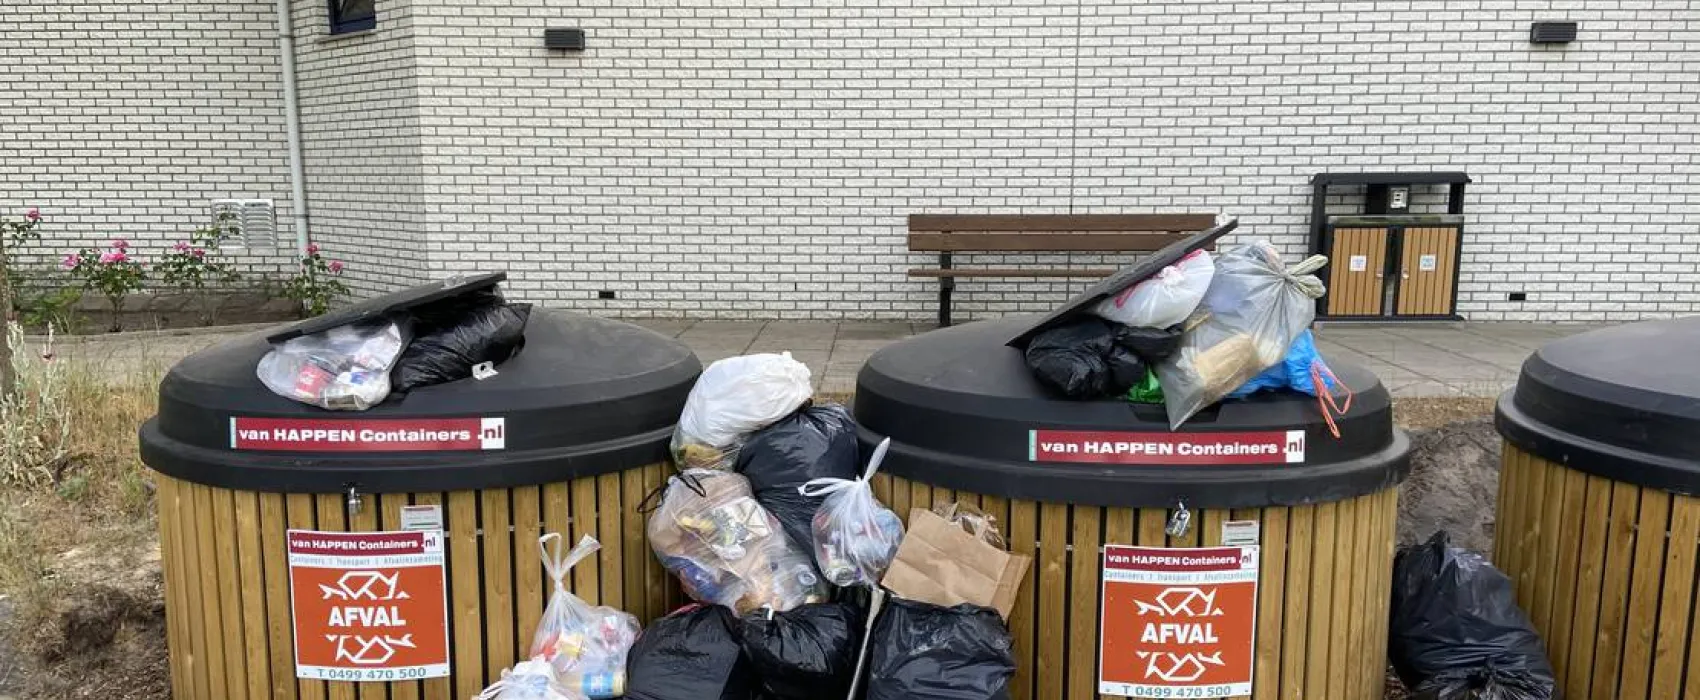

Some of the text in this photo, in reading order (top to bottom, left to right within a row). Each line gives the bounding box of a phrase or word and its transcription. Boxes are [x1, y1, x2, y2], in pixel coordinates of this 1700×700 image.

[239, 429, 269, 440] van
[273, 428, 356, 442] HAPPEN
[360, 428, 471, 442] Containers
[1041, 442, 1079, 453] van
[1083, 441, 1174, 455] HAPPEN
[1177, 441, 1278, 455] Containers
[292, 539, 311, 548] van
[312, 540, 357, 550] HAPPEN
[359, 539, 418, 550] Containers
[1108, 554, 1130, 563] van
[1132, 555, 1180, 566] HAPPEN
[1182, 555, 1236, 566] Containers
[328, 605, 407, 627] AFVAL
[1140, 622, 1219, 644] AFVAL
[317, 667, 427, 679] T 0499 470 500
[1122, 685, 1231, 697] T 0499 470 500
